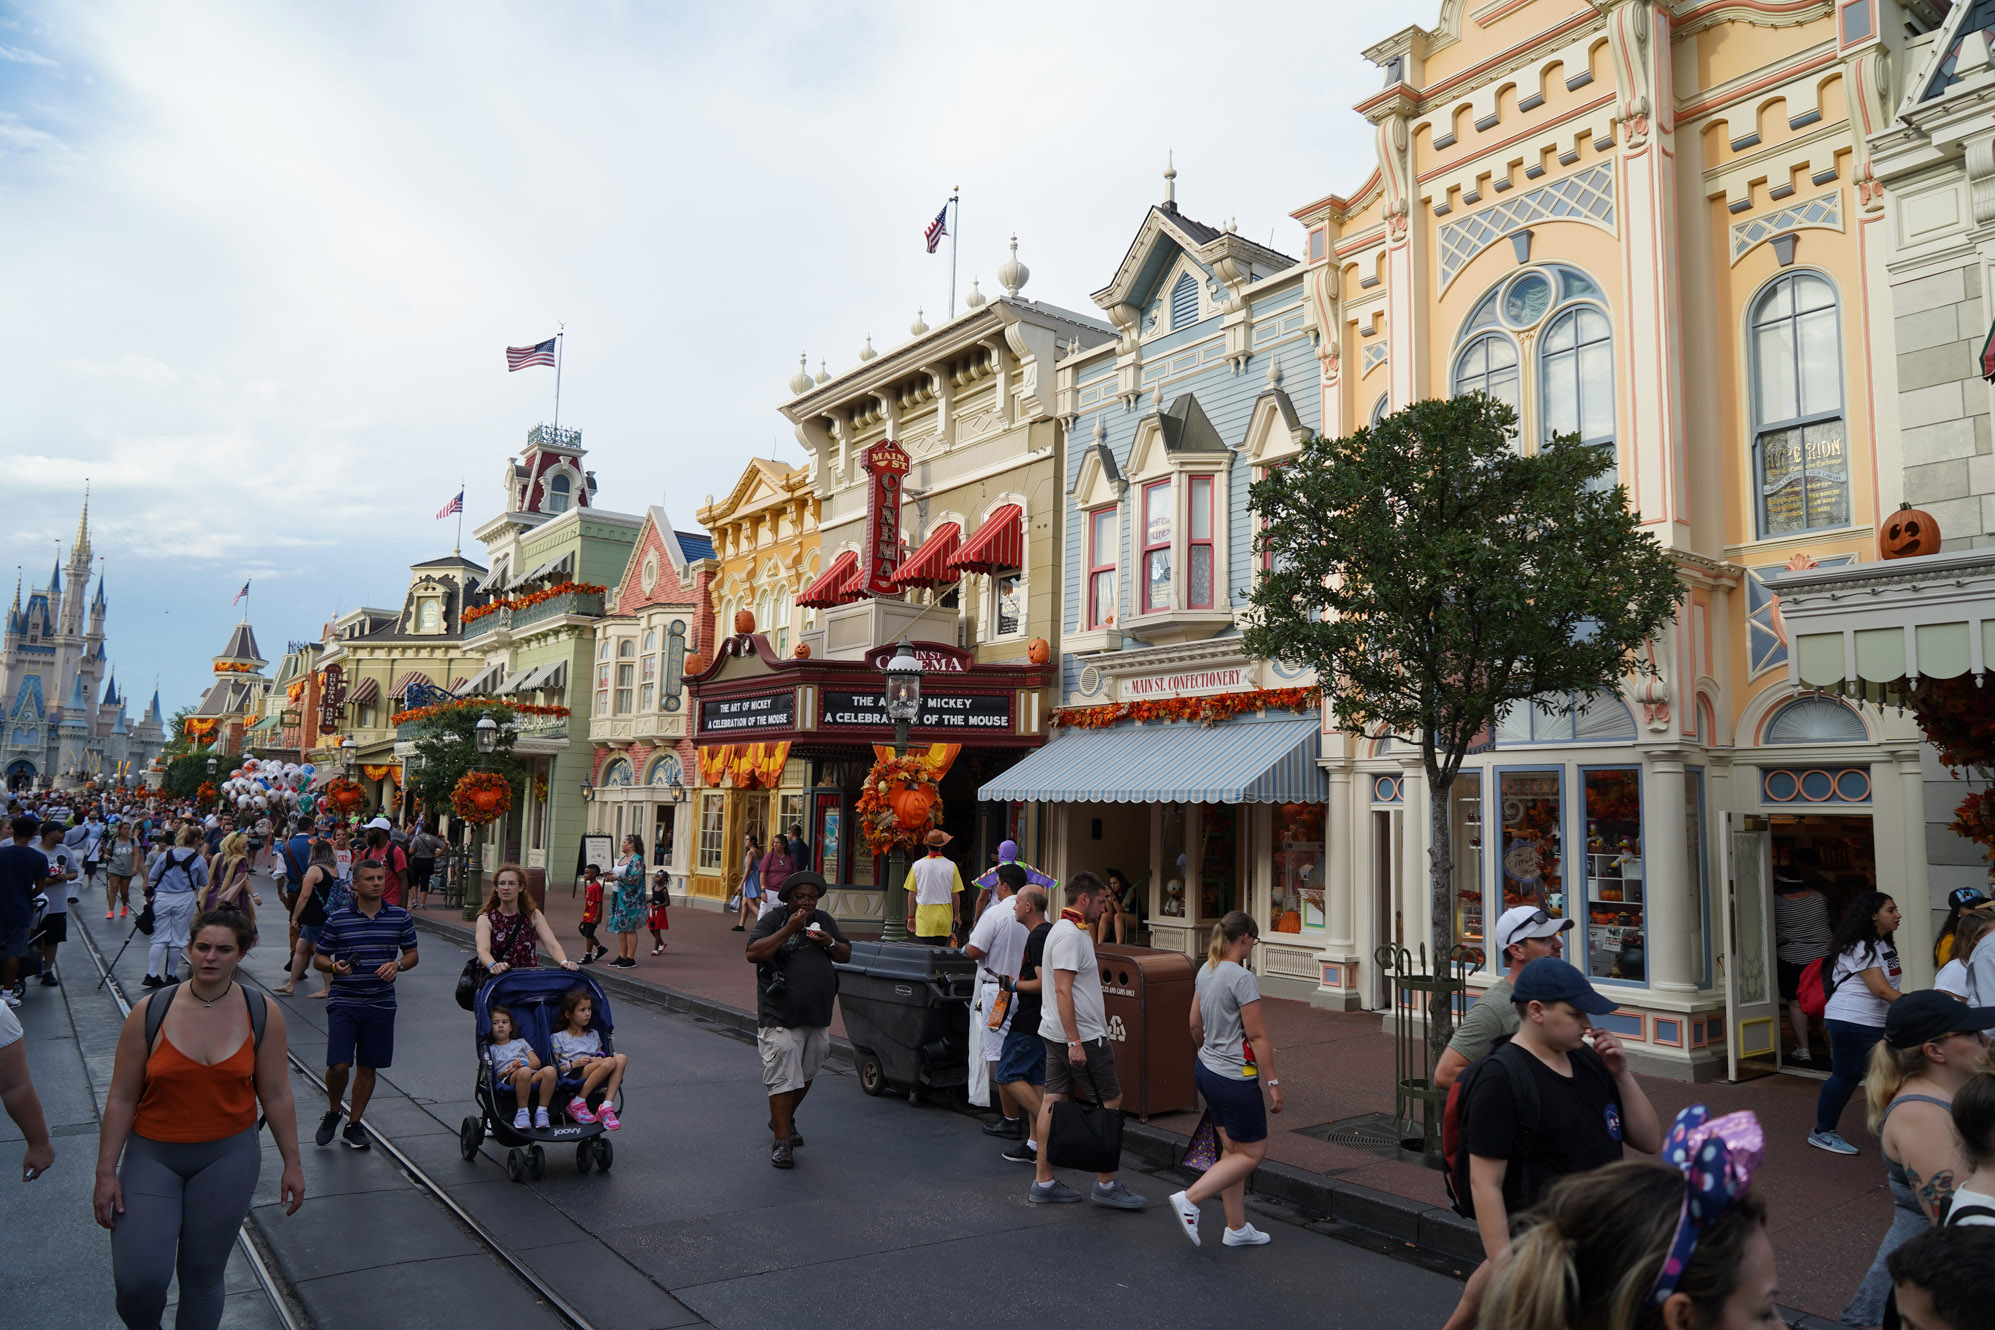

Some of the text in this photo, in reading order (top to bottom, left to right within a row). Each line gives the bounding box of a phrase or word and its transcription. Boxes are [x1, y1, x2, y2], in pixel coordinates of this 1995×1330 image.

[872, 453, 905, 462] MAIN
[891, 460, 908, 470] ST.
[875, 472, 899, 578] CINEMA
[875, 655, 963, 671] CEMA
[328, 673, 336, 703] CRYSTAL
[1131, 669, 1241, 694] MAIN ST. CONFECTIONERY
[720, 699, 772, 713] THE ART OF MICKEY
[852, 696, 874, 706] THE
[927, 698, 972, 709] MICKEY
[712, 717, 747, 729] CELEBRATION
[748, 716, 756, 726] OF
[756, 715, 767, 725] THE
[768, 713, 787, 724] MOUSE
[824, 712, 1008, 727] A CELEBRAN OF THE MOUSE
[49, 865, 64, 874] AD
